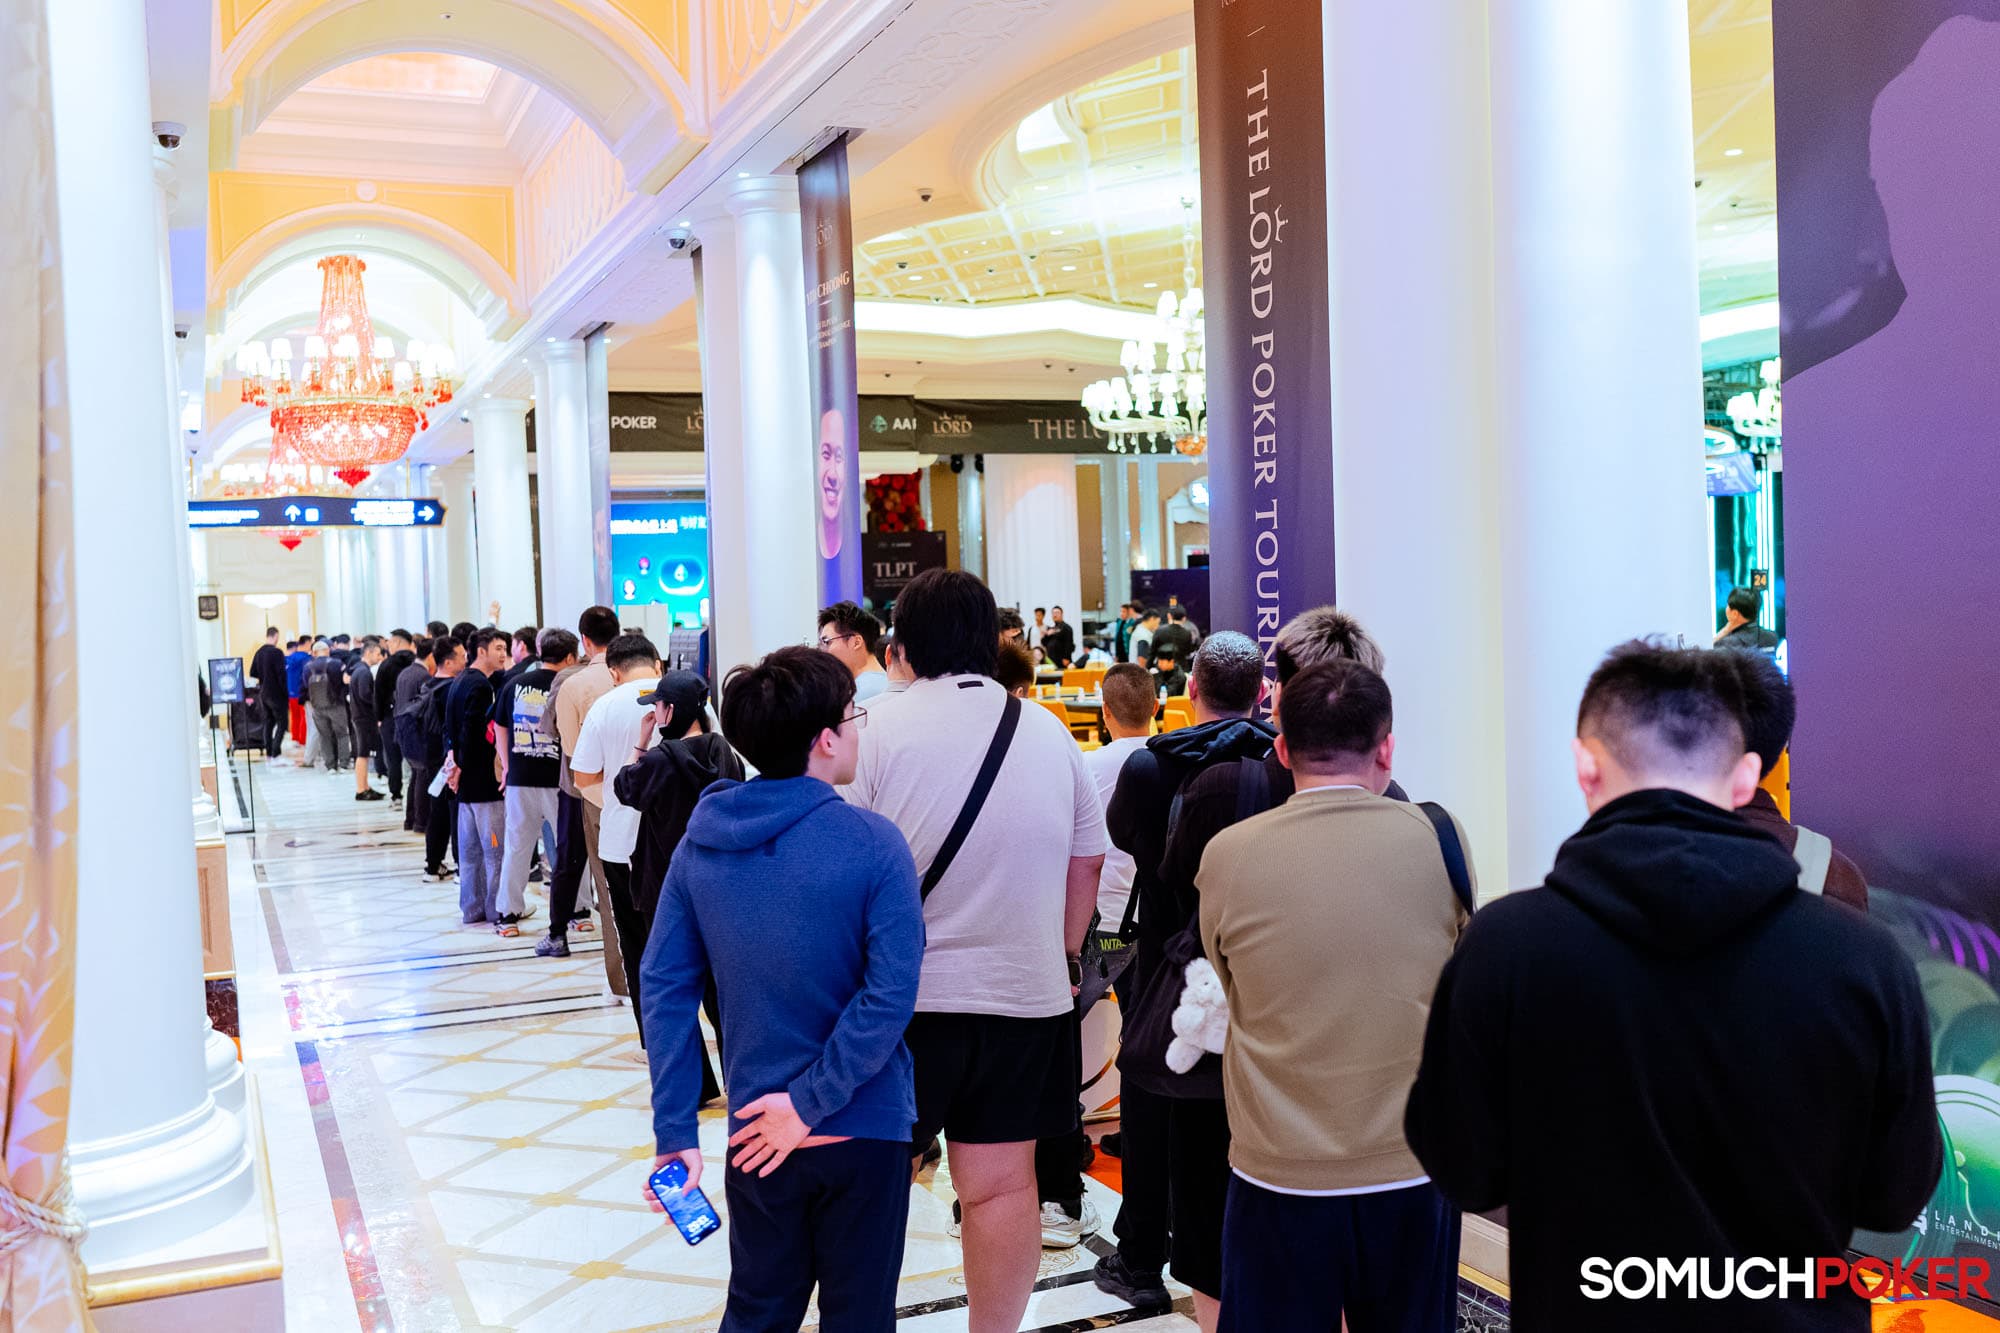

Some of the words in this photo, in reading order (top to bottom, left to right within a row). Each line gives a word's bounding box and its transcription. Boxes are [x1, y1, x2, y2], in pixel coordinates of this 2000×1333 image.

[1247, 68, 1270, 177] THE
[1249, 186, 1273, 319] LORD
[610, 416, 657, 429] POKER
[1251, 329, 1277, 488] POKER
[932, 420, 973, 434] LORD
[1028, 419, 1077, 439] THE
[873, 561, 917, 577] TLPT
[1255, 499, 1280, 723] TOURNA
[1935, 1210, 2000, 1242] LAND
